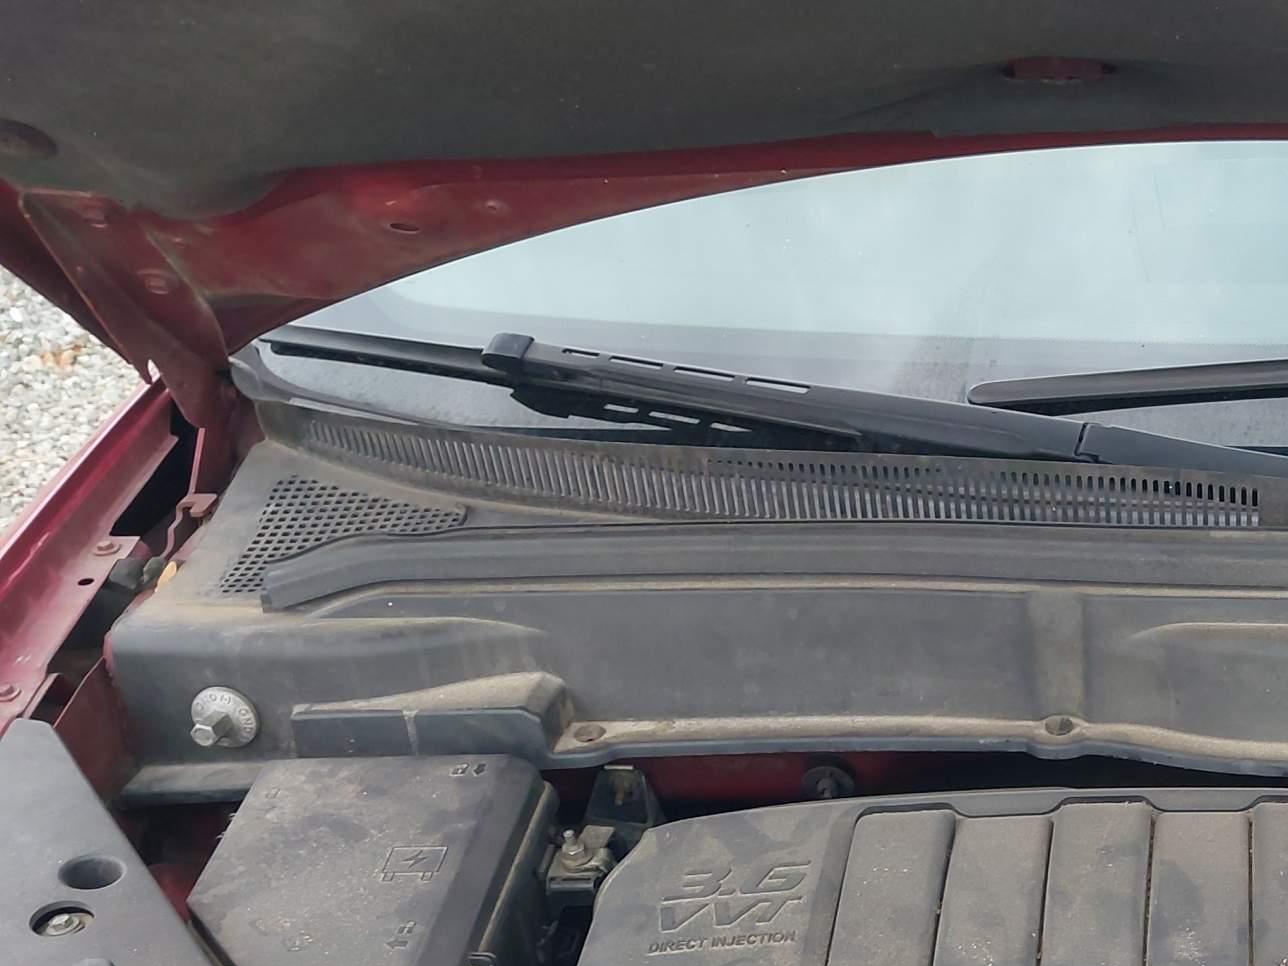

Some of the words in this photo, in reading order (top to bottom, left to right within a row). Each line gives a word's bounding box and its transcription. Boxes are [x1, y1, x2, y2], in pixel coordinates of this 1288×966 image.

[661, 860, 813, 903] 3.6
[658, 896, 805, 934] VVT
[648, 937, 707, 955] DIRECT
[710, 930, 797, 951] INJECTION
